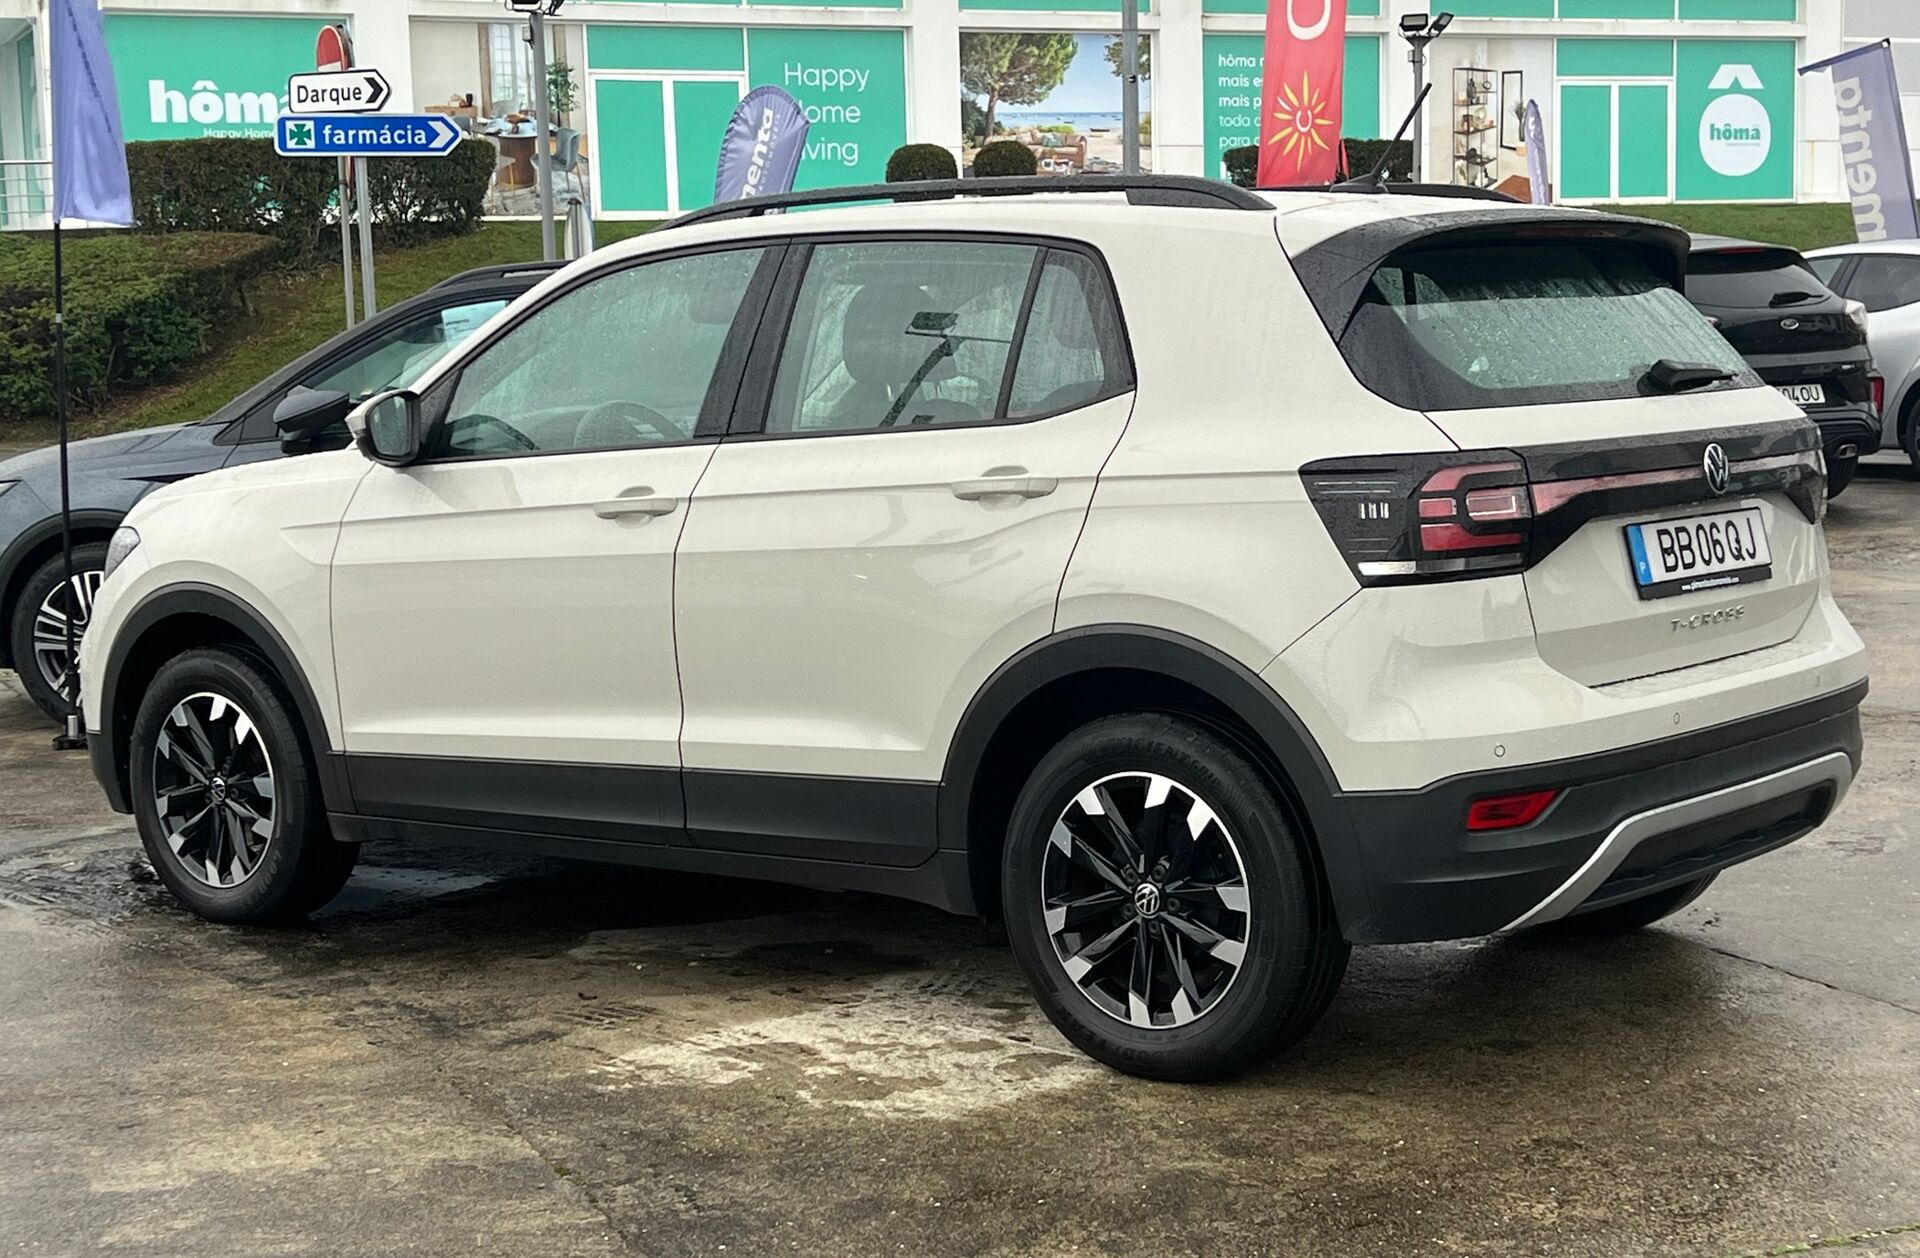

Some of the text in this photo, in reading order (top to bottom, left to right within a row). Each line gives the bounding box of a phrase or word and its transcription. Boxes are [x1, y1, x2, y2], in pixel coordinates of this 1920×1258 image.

[1218, 54, 1256, 67] hôma
[784, 62, 870, 92] Happy
[1218, 74, 1250, 87] mais
[297, 84, 362, 105] Darque
[1218, 94, 1250, 107] mais
[799, 100, 861, 124] ome
[1218, 114, 1251, 127] toda
[244, 127, 275, 140] Hom
[322, 124, 427, 145] farmácia
[1219, 135, 1251, 149] para
[802, 136, 859, 167] ving
[1776, 385, 1821, 402] 04OU
[1669, 604, 1745, 632] T-CROSS
